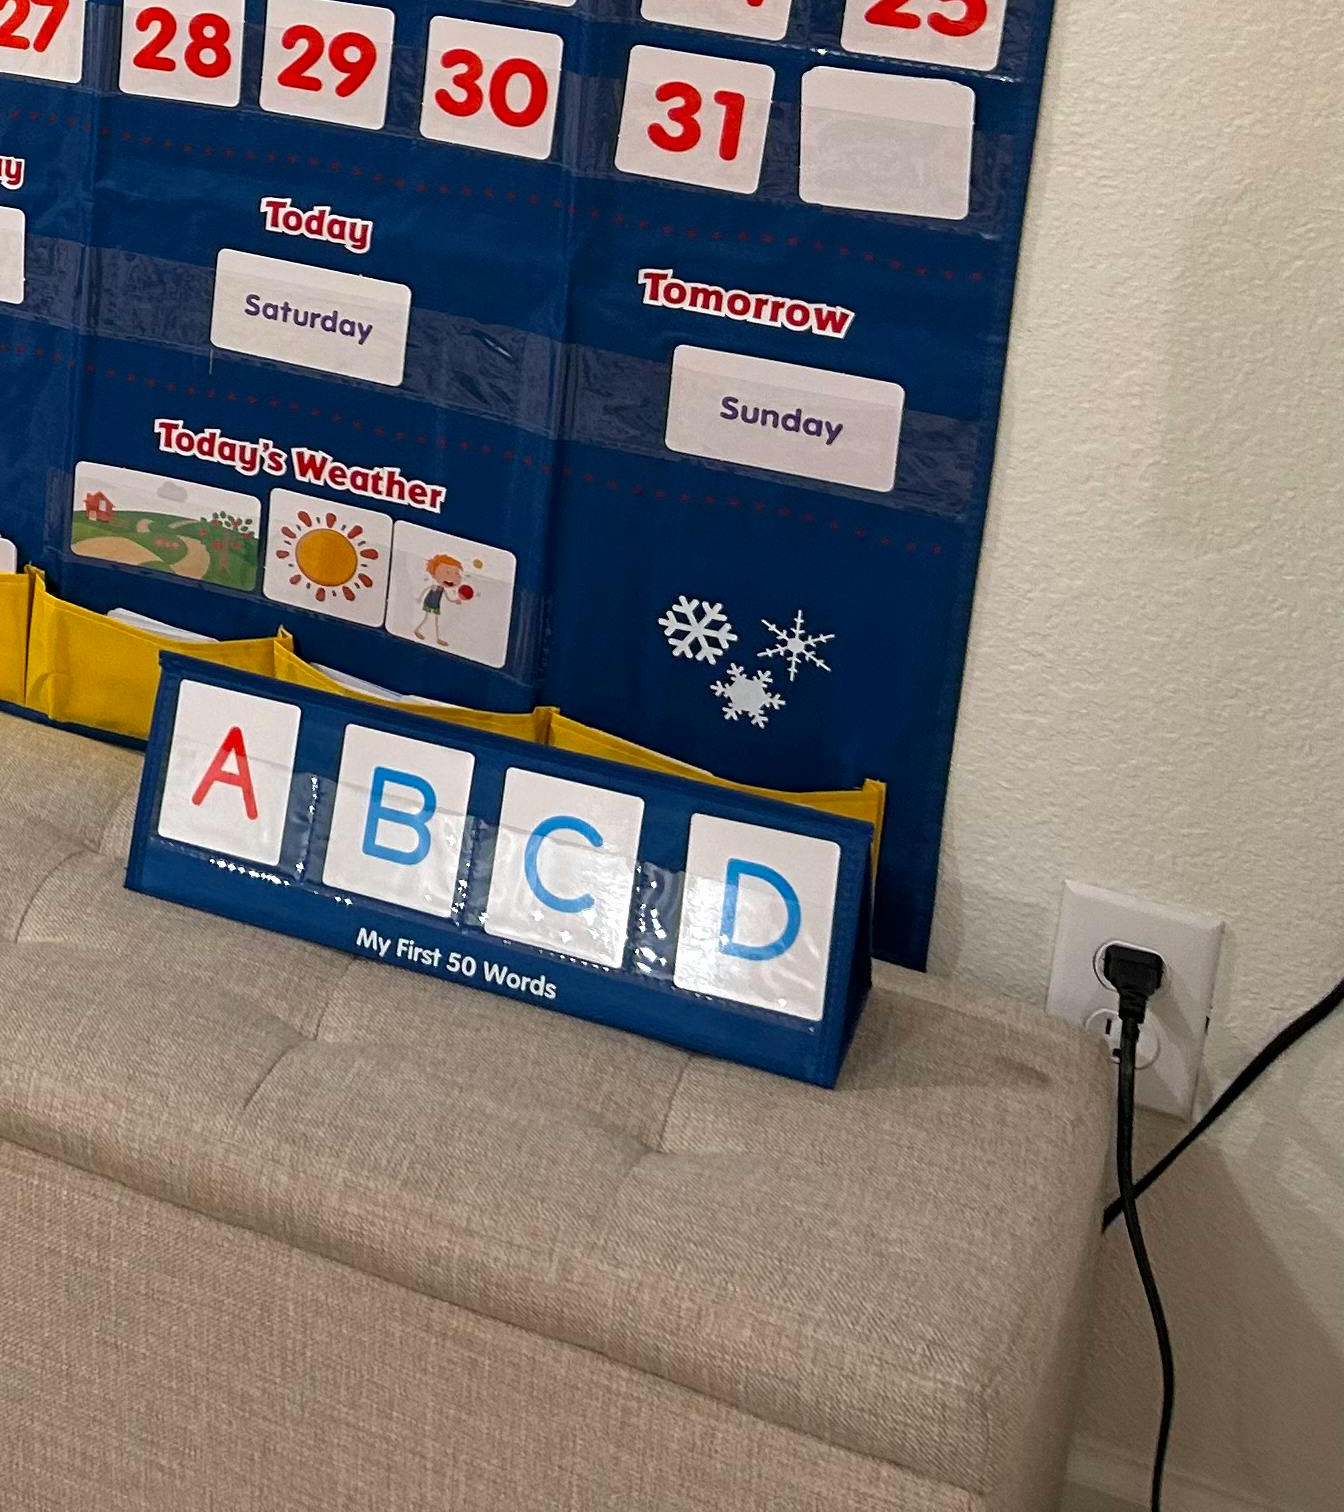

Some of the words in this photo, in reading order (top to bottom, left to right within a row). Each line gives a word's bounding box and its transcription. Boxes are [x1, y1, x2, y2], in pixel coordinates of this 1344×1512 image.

[132, 7, 232, 79] 28
[277, 24, 377, 99] 29
[434, 48, 548, 128] 30
[647, 81, 745, 162] 31
[260, 197, 373, 253] Today
[243, 294, 373, 345] Saturday
[638, 268, 855, 339] Tomorrow
[720, 396, 843, 446] Sunday
[154, 419, 290, 479] Today's
[294, 449, 446, 513] Weather
[191, 725, 259, 821] A
[361, 765, 438, 866] B
[523, 814, 604, 913] C
[719, 857, 802, 961] D
[356, 926, 392, 958] My
[396, 936, 441, 968] First
[446, 951, 477, 977] 50
[483, 962, 558, 1000] Words
